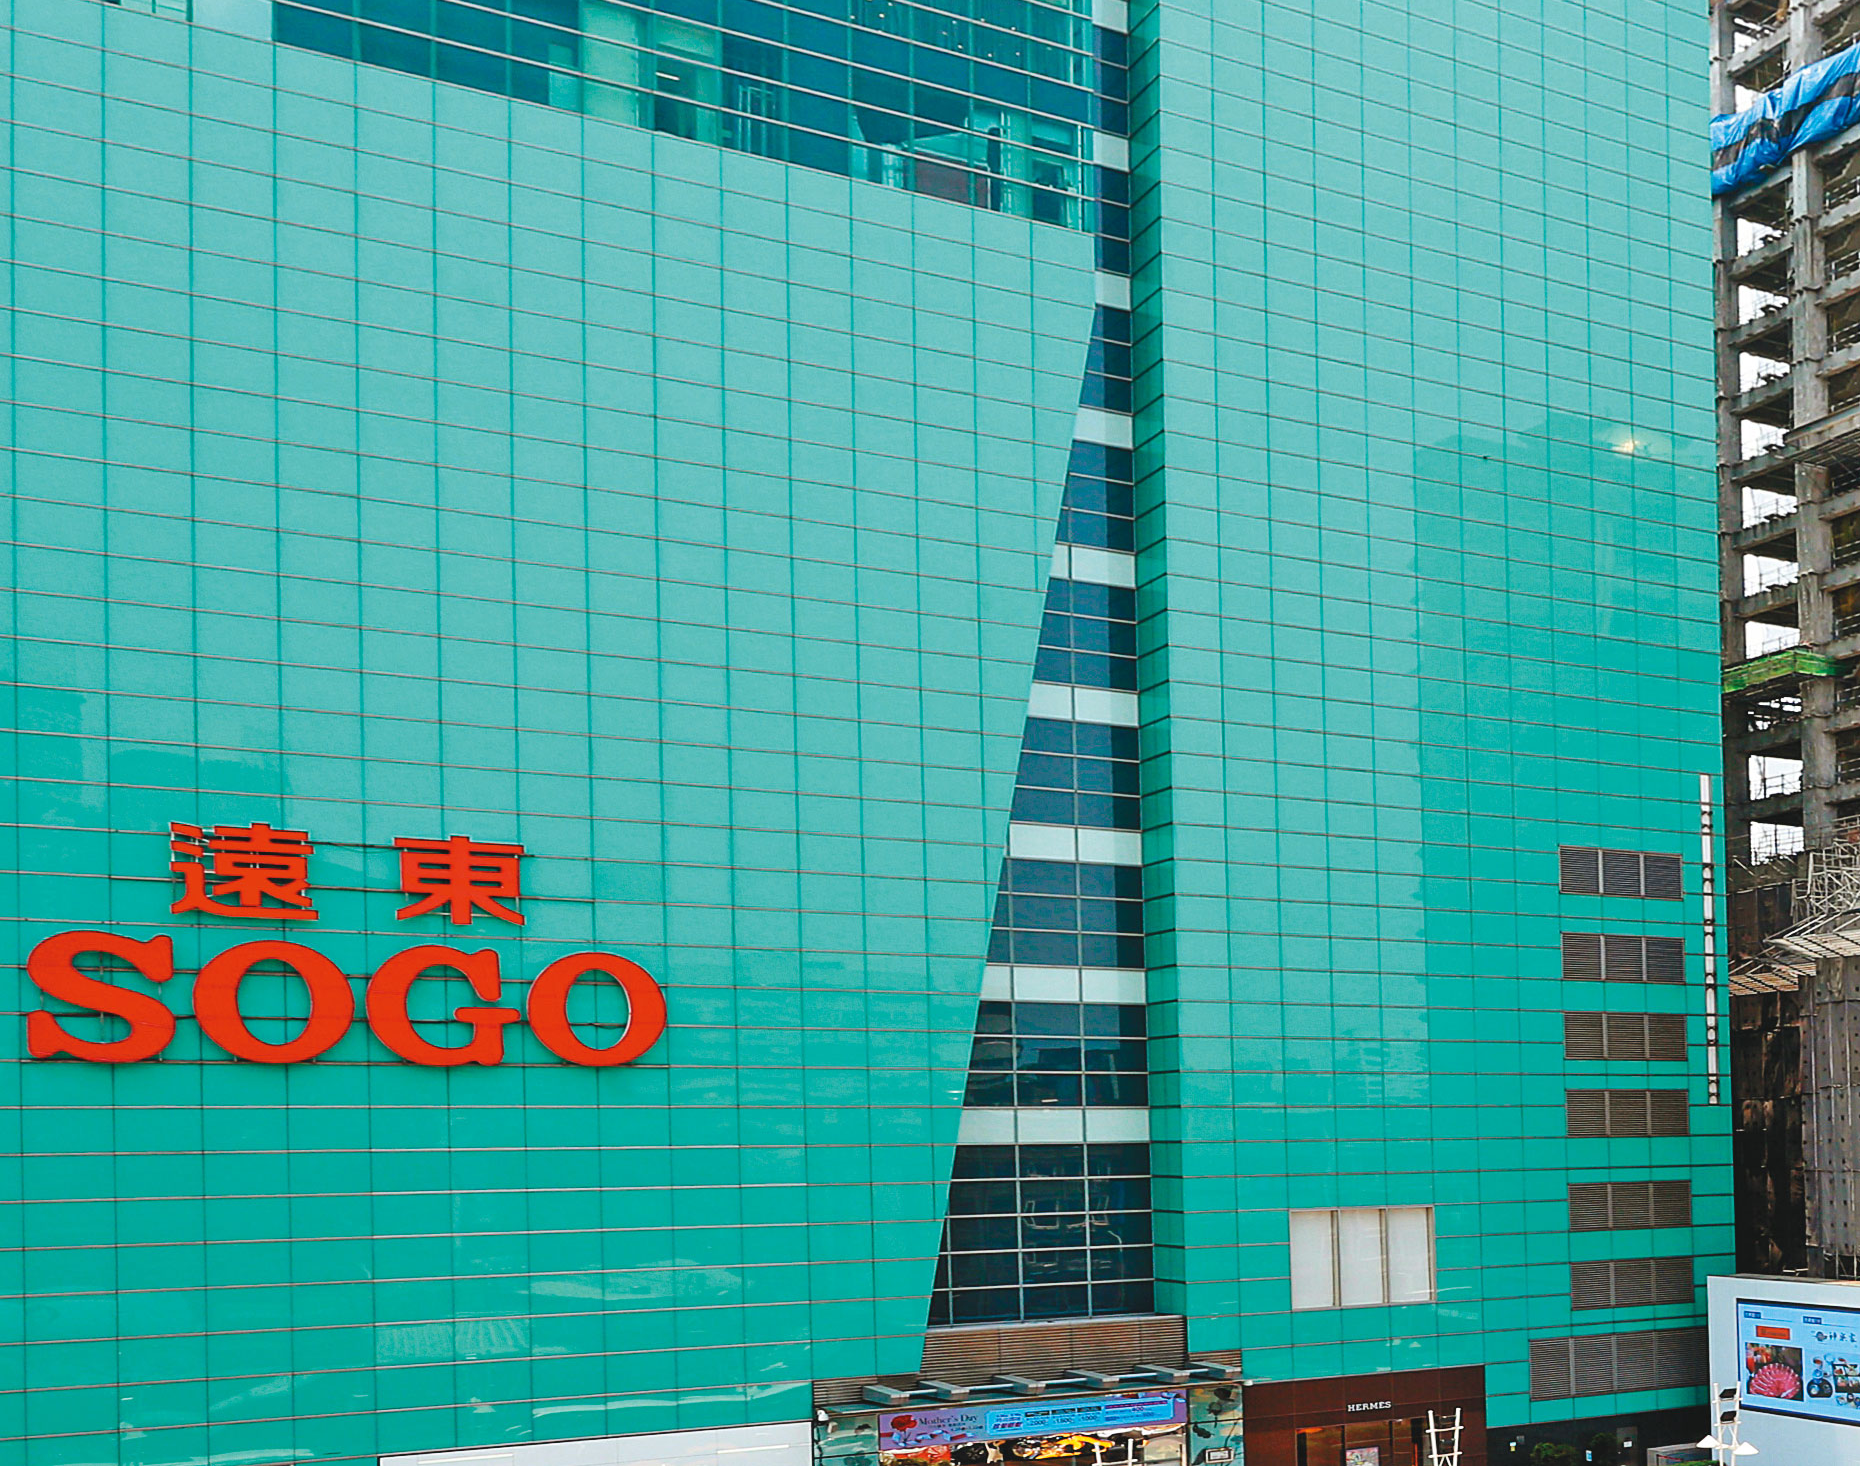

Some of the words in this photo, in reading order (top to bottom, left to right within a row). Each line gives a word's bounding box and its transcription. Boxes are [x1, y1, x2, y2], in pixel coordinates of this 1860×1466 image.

[170, 821, 526, 926] 遠東
[26, 930, 668, 1067] SOGO
[961, 1414, 977, 1423] Day
